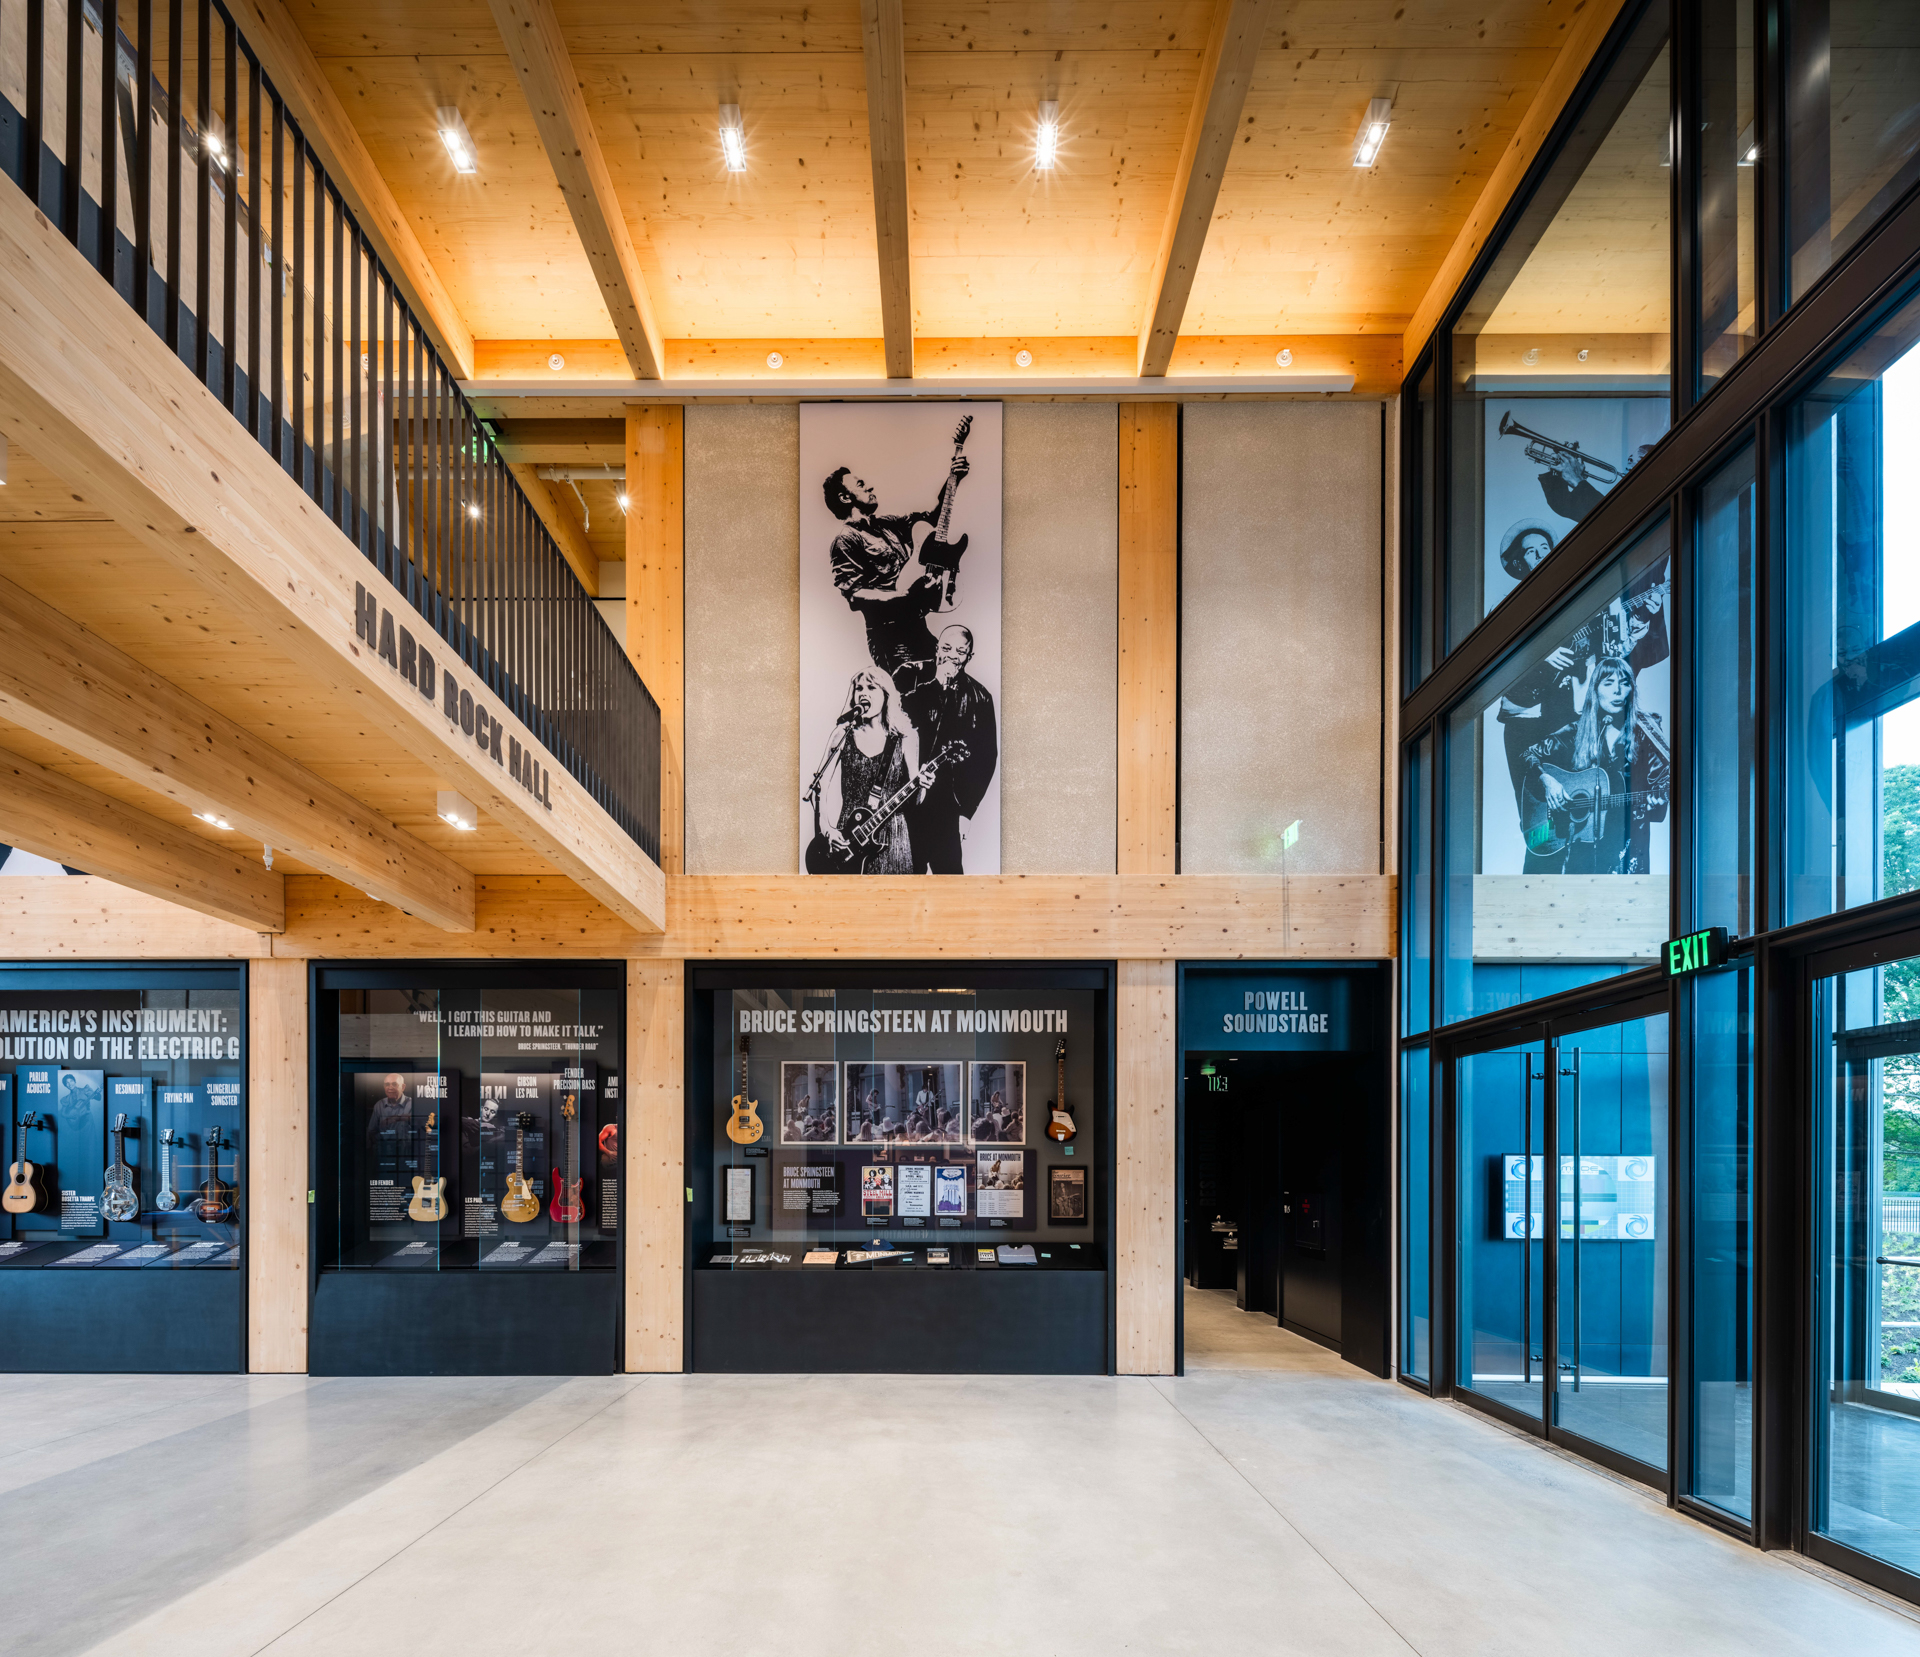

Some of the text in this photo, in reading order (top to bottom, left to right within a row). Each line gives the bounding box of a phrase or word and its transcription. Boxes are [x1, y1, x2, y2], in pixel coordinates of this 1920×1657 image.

[355, 580, 552, 811] HARD ROCK HALL
[1669, 931, 1711, 975] EXIT
[1244, 991, 1308, 1011] POWELL
[0, 1010, 227, 1033] AMERICA'S INSTRUMENT:
[448, 1010, 452, 1023] I
[454, 1010, 472, 1023] GOT
[474, 1010, 495, 1023] THIS
[497, 1010, 530, 1023] GUITAR
[532, 1010, 551, 1023] AND
[739, 1010, 1068, 1033] BRUCE SPRINGSTEEN AT MONMOUTH
[1223, 1013, 1329, 1033] SOUNDSTAGE
[448, 1025, 604, 1037] I LEARNED HOW TO MAKE IT TALK."
[73, 1036, 96, 1060] OF
[100, 1036, 134, 1060] THE
[138, 1036, 223, 1060] ELECTRIC
[227, 1036, 240, 1060] G
[532, 1043, 562, 1051] SPRINGSTEEN,
[28, 1072, 49, 1082] PARLOR
[564, 1068, 584, 1078] FENDER
[427, 1076, 447, 1086] FENDER
[517, 1076, 537, 1087] GIBSON
[553, 1080, 596, 1090] PRECISION BASS
[26, 1083, 51, 1093] ACOUSTIC
[515, 1088, 539, 1098] LES PAUL
[164, 1092, 194, 1103] FRYING PAN
[211, 1095, 238, 1106] SONGSTER
[980, 1153, 992, 1161] BRUCE
[783, 1166, 835, 1177] BRUCE SPRINGSTEEN
[783, 1178, 821, 1189] AT MONMOUTH
